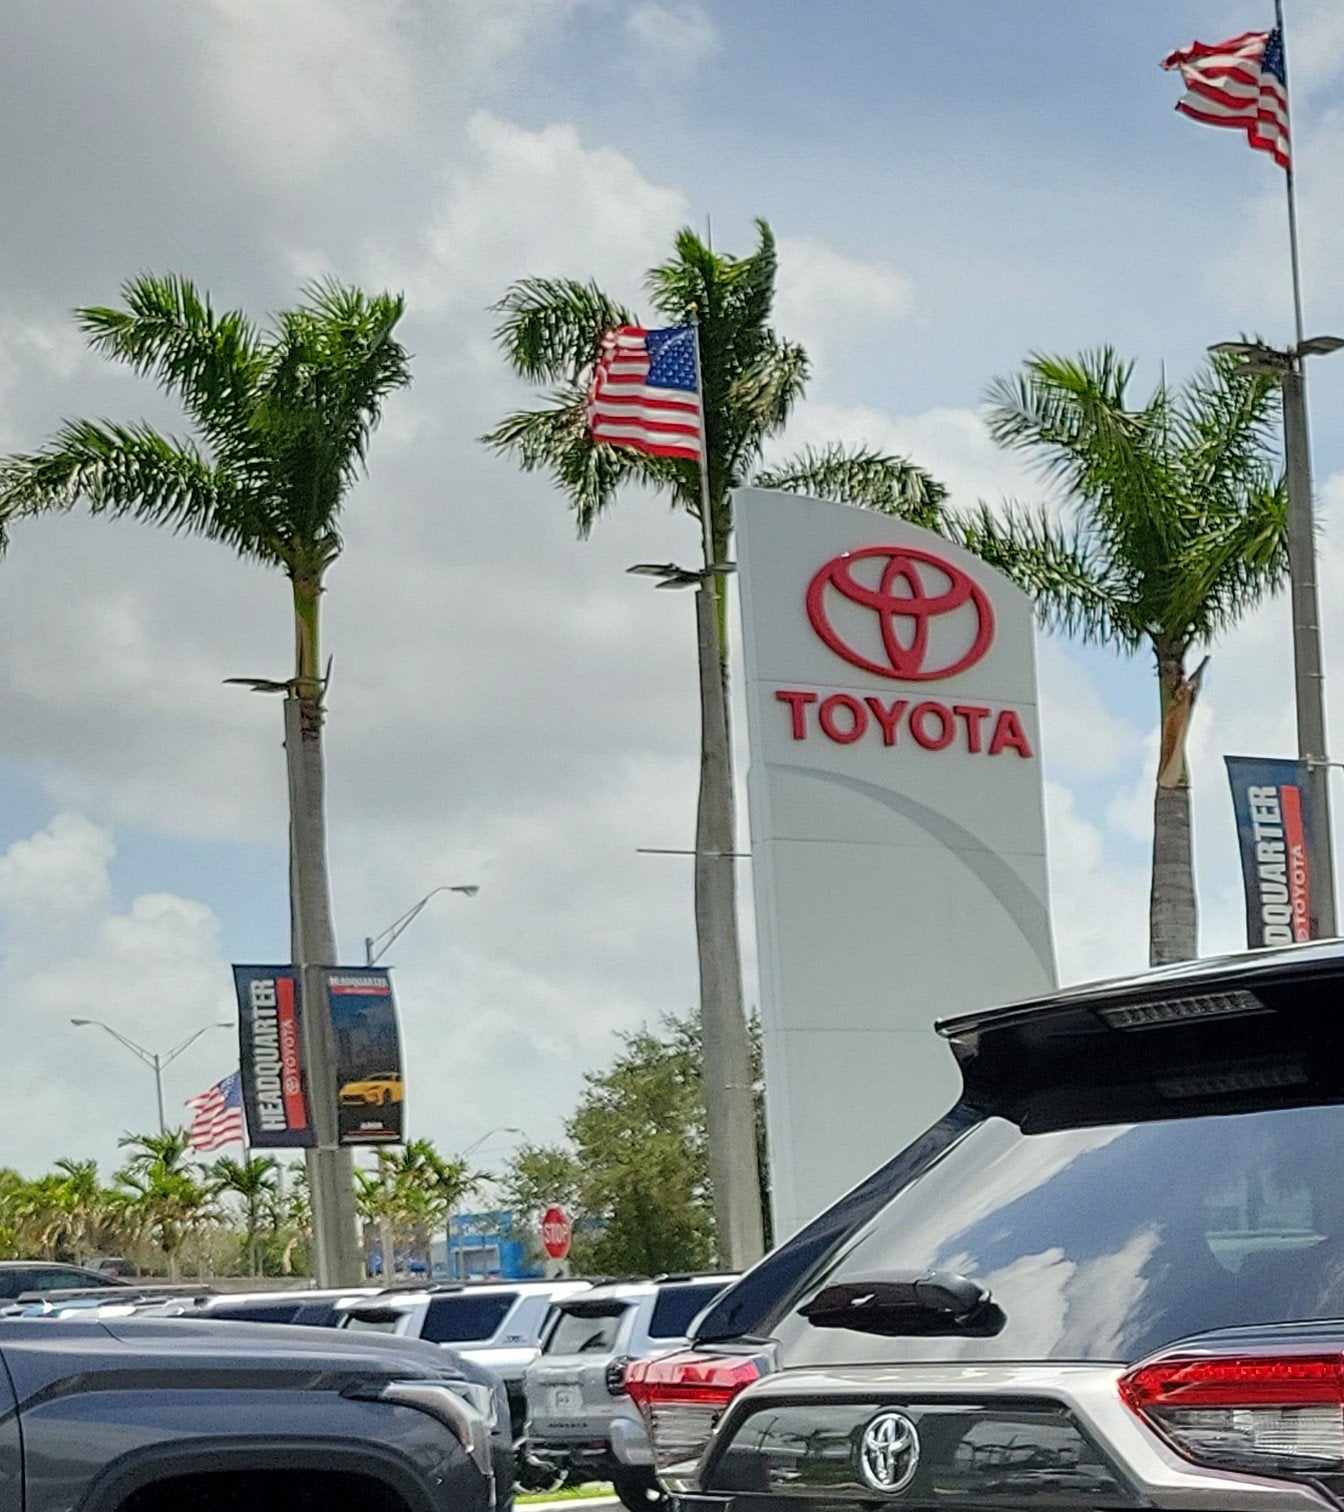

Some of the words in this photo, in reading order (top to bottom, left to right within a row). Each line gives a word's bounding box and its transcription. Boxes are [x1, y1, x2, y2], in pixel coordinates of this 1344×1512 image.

[775, 690, 1033, 758] TOYOTA
[1248, 785, 1293, 946] DQUARTER
[1291, 844, 1308, 920] TOYOTA
[250, 979, 287, 1131] HEADQUARTER
[282, 1019, 298, 1075] TOYOTA
[545, 1222, 569, 1244] STOP
